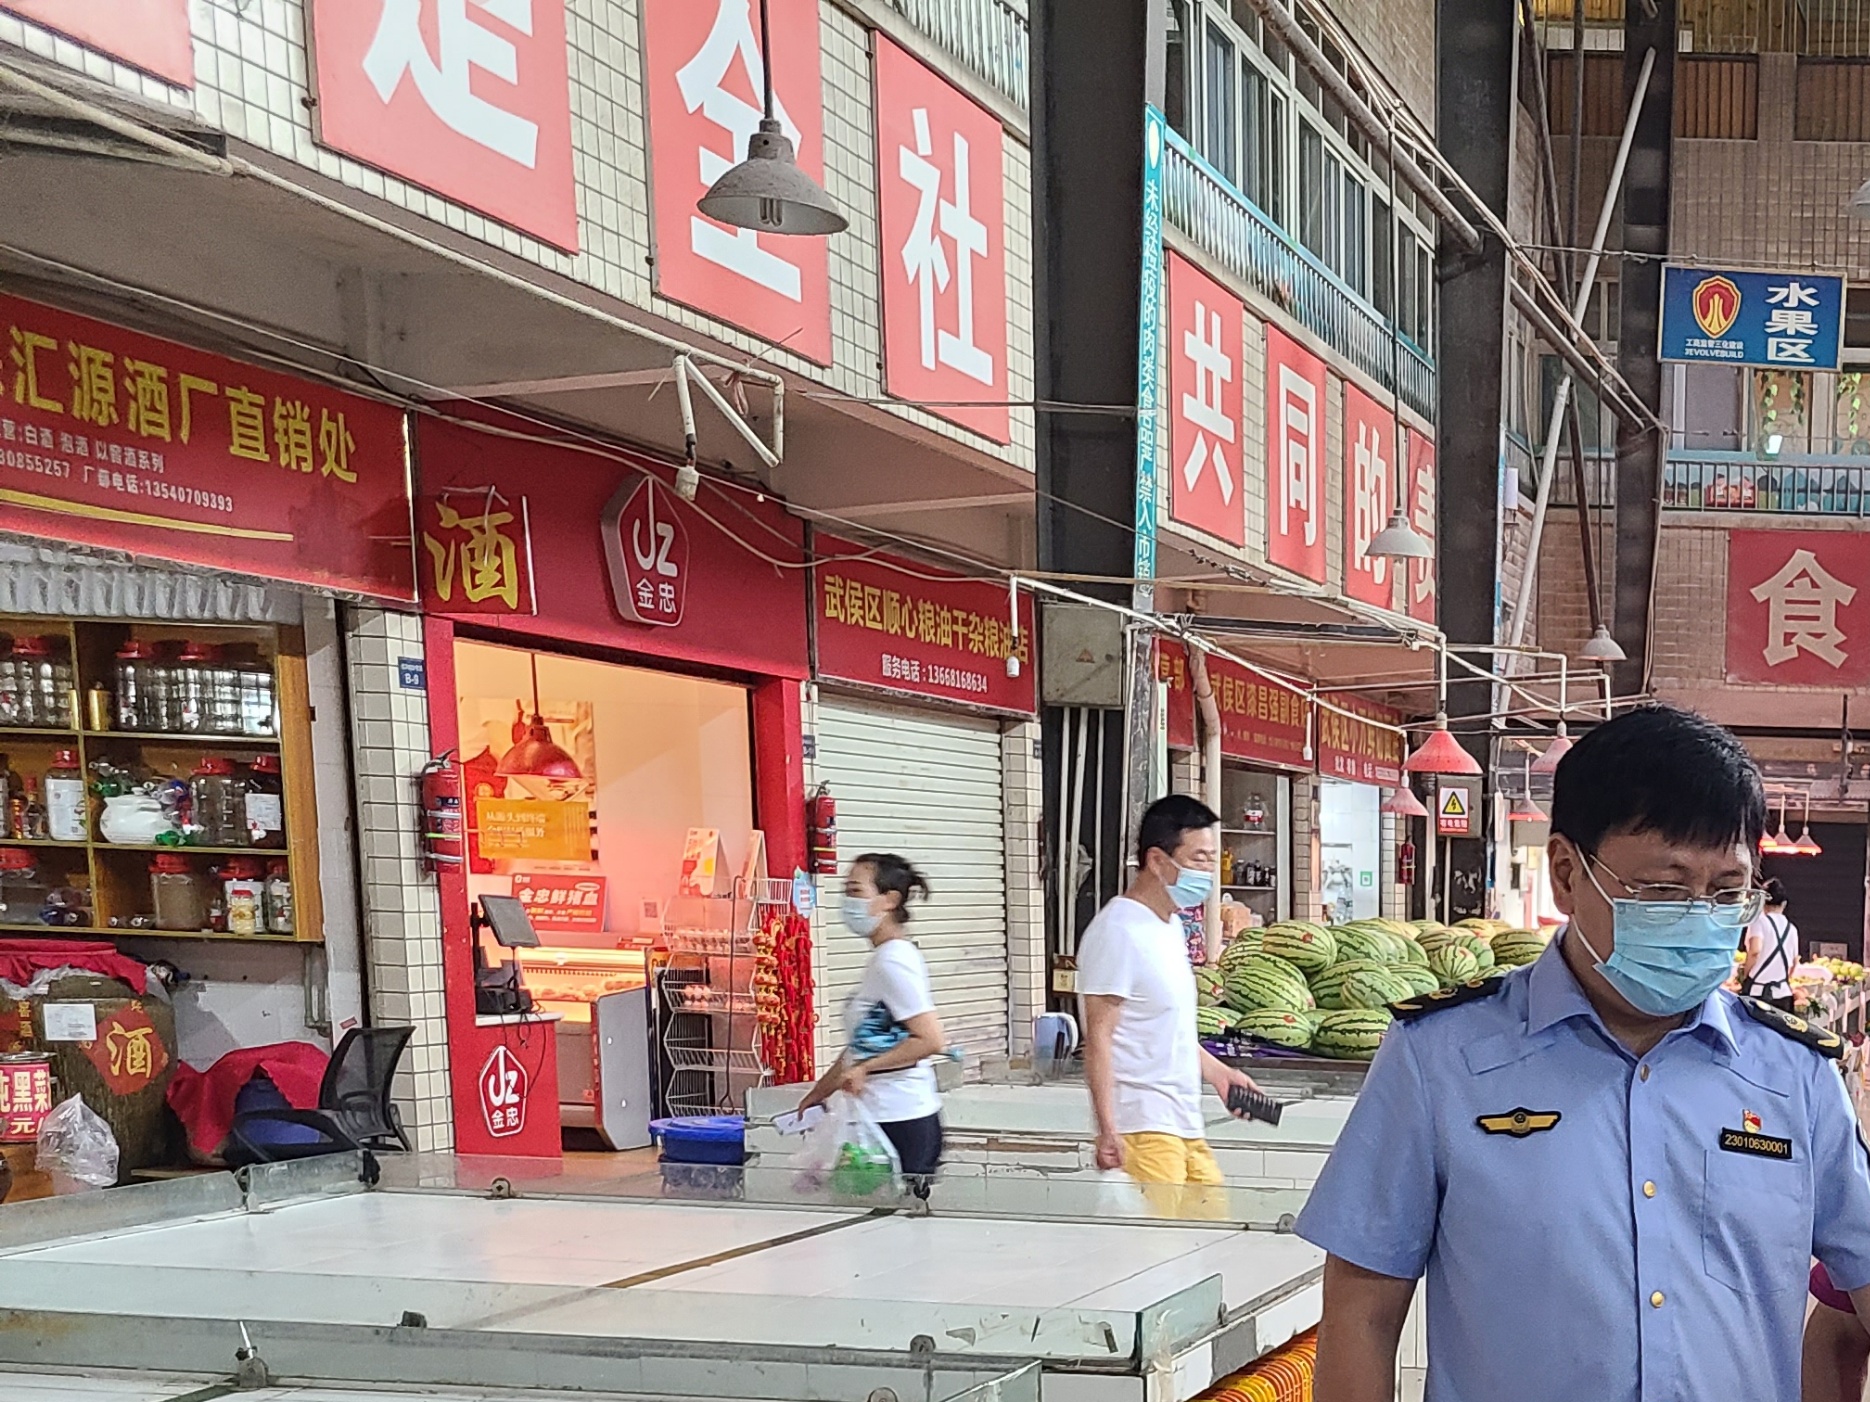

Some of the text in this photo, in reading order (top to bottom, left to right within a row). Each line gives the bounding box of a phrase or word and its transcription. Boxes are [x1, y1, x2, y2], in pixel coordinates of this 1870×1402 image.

[1763, 282, 1821, 363] 水果区
[0, 326, 357, 483] 汇源酒厂直销处
[423, 501, 519, 610] 酒
[635, 577, 677, 615] 金忠
[106, 1021, 154, 1078] 酒
[491, 1107, 520, 1129] 金忠
